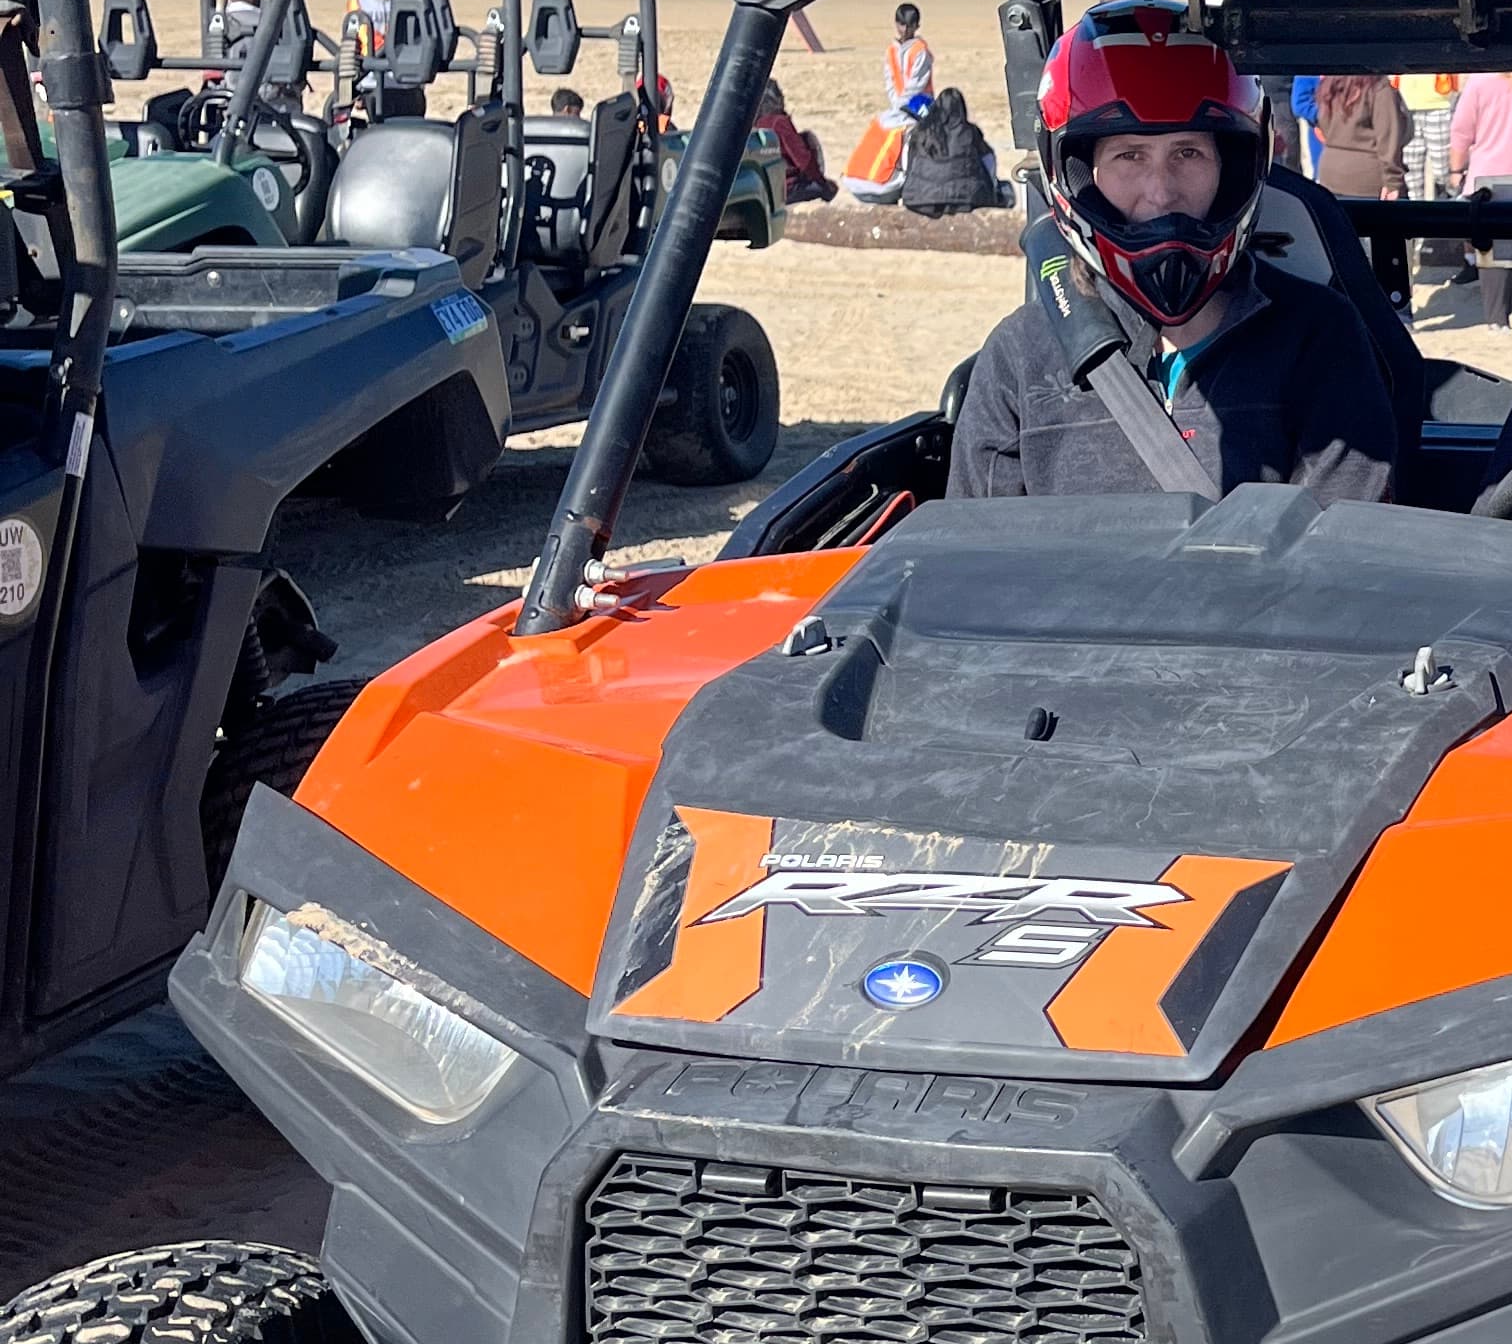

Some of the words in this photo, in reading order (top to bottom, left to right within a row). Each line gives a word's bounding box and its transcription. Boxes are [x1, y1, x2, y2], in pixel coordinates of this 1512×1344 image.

[759, 853, 885, 869] POLARIS
[686, 870, 1195, 930] RZR
[662, 1059, 1088, 1128] POLARIS
